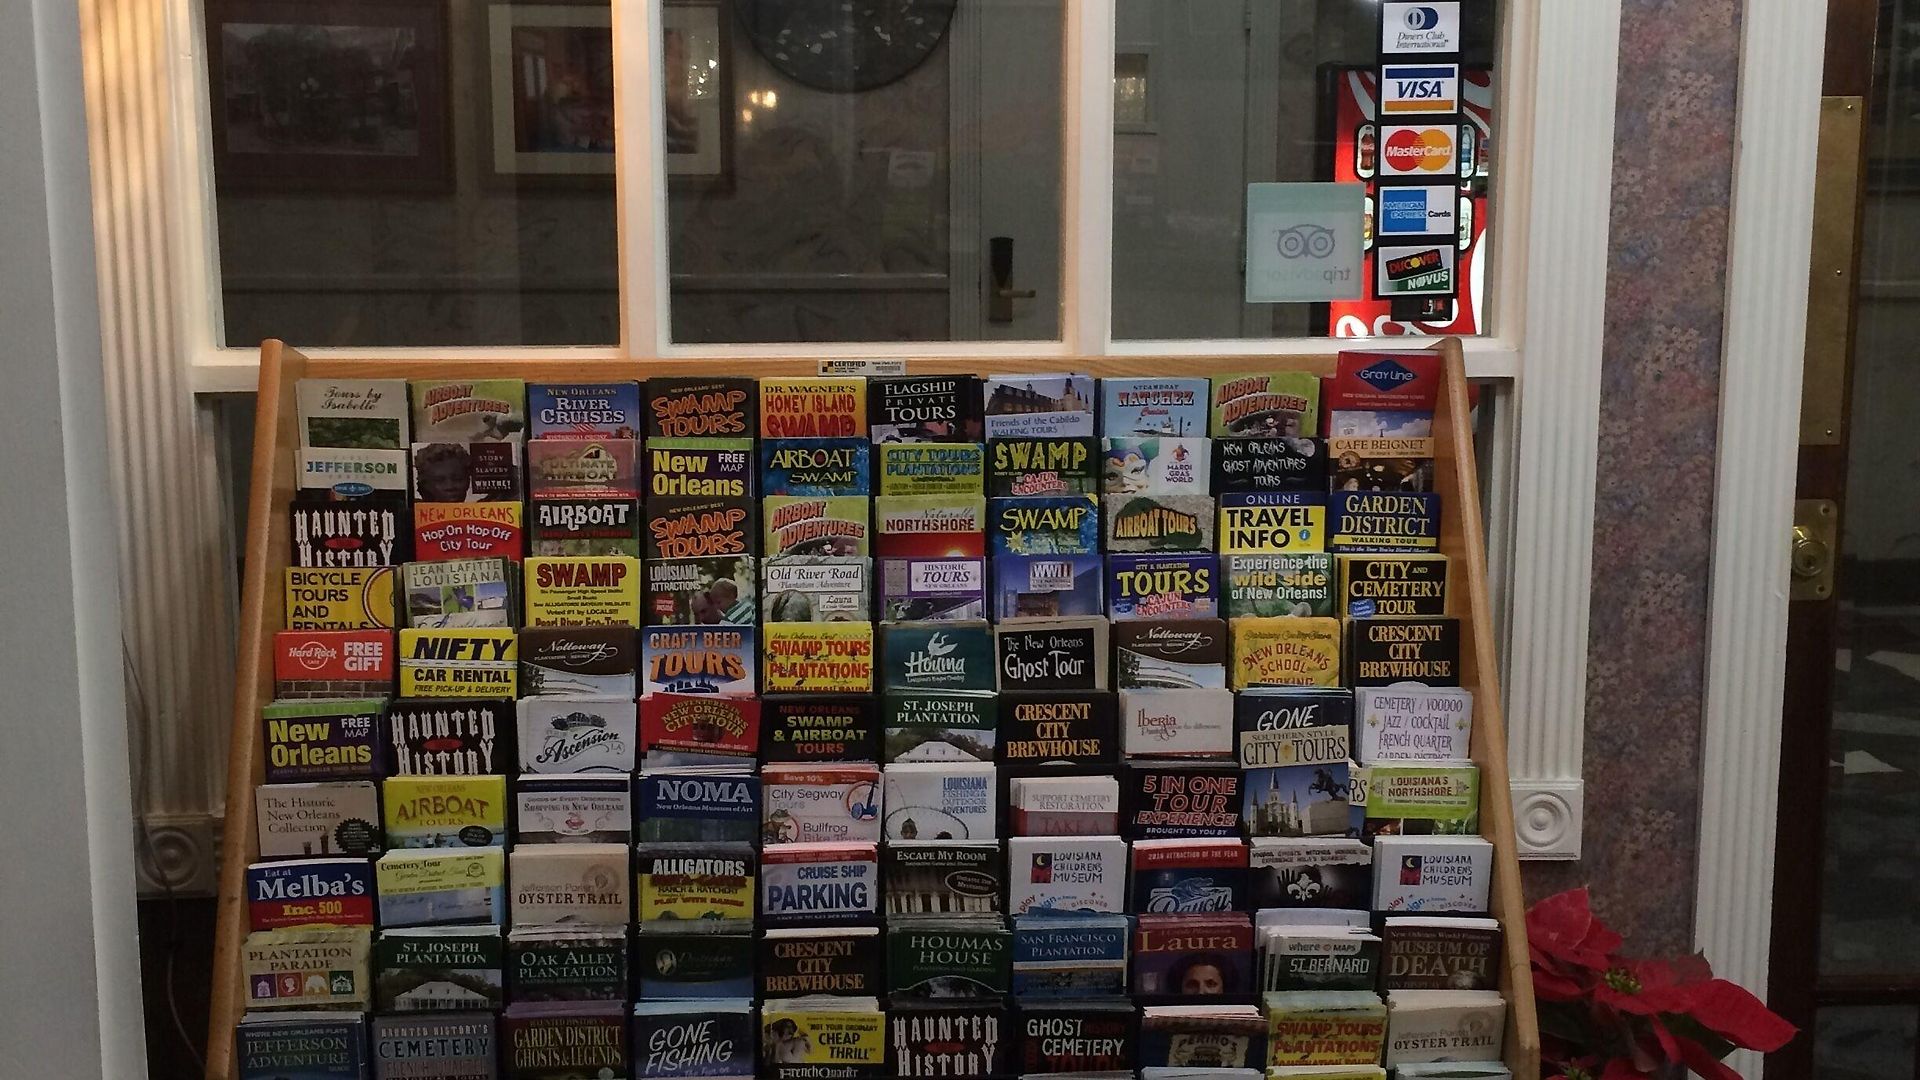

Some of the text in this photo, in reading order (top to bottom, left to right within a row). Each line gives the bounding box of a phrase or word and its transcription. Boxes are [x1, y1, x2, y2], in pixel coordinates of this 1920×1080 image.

[1397, 81, 1442, 98] VISA
[1386, 144, 1451, 157] MasterCard
[1391, 210, 1451, 219] EXPRESS Cards
[885, 382, 956, 395] FLAGSHIP
[1216, 377, 1270, 406] AIRBOAT
[424, 385, 473, 408] AIRBOAT
[885, 396, 955, 406] PRIVATE
[1118, 391, 1194, 407] NATCHEZ
[557, 399, 610, 410] RIVER
[651, 391, 746, 417] SWAMP
[766, 395, 856, 413] HONEY ISLAND
[1223, 396, 1307, 425] ADVENTURES
[432, 400, 510, 425] ADVENTURES
[541, 409, 625, 423] CRUISES
[885, 406, 956, 422] TOURS
[1223, 442, 1285, 456] NEW ORLEANS
[1336, 439, 1425, 450] CAFE BEIGNET
[653, 451, 745, 472] New FREE
[994, 441, 1087, 471] SWAMP
[306, 462, 397, 474] JEFFERSON
[721, 464, 743, 472] MAP
[653, 474, 744, 496] Orleans
[1254, 476, 1281, 486] TOURS
[1246, 495, 1300, 504] ONLINE
[1346, 495, 1427, 514] GARDEN
[420, 507, 515, 523] NEW ORLEANS
[540, 504, 629, 531] AIRBOAT
[772, 501, 826, 532] AIRBOAT
[1000, 507, 1087, 531] SWAMP
[1227, 509, 1314, 528] TRAVEL
[650, 509, 745, 538] SWAMP
[886, 518, 975, 531] NORTHSHORE
[1116, 510, 1196, 539] AIRBOAT TOURS
[1340, 516, 1430, 535] DISTRICT
[779, 520, 865, 551] ADVENTURES
[1230, 529, 1290, 549] INFO
[440, 540, 492, 551] City Tour
[657, 531, 745, 558] TOURS
[412, 561, 500, 575] JEAN LAFITTE
[537, 563, 627, 587] SWAMP
[650, 564, 698, 581] LOUISIANA
[770, 568, 859, 579] Old River Road
[291, 572, 361, 585] BICYCLE
[923, 571, 971, 583] TOURS
[1117, 569, 1210, 597] TOURS
[651, 582, 700, 591] ATTRACTIONS
[292, 589, 348, 601] TOURS
[293, 606, 329, 618] AND
[1378, 601, 1416, 614] TOUR
[650, 632, 742, 649] CRAFT BEER
[1369, 625, 1443, 642] CRESCENT
[343, 642, 383, 656] FREE
[413, 638, 514, 661] NIFTY
[1004, 636, 1084, 651] The New Orleans
[1389, 644, 1422, 659] CITY
[344, 657, 383, 671] GIFT
[650, 651, 746, 681] TOURS
[770, 662, 869, 678] PLANTATIONS
[1360, 661, 1450, 678] BREWHOUSE
[414, 669, 511, 683] CAR RENTAL
[903, 701, 974, 712] ST. JOSEPH
[1015, 703, 1091, 721] CRESCENT
[787, 716, 853, 728] SWAMP
[897, 712, 980, 724] PLANTATION
[1257, 704, 1319, 731] GONE
[269, 718, 371, 743] New FREE
[345, 729, 369, 737] MAP
[773, 729, 867, 742] & AIRBOAT
[1036, 722, 1070, 739] CITY
[795, 743, 844, 754] TOURS
[1007, 740, 1100, 758] BREWHOUSE
[1244, 737, 1346, 765] CITY TOURS
[657, 779, 753, 803] NOMA
[1143, 776, 1237, 795] 5 IN ONE
[1388, 787, 1452, 796] NORTHSHORE
[772, 790, 845, 800] City Segway
[265, 797, 336, 808] The Historic
[1039, 801, 1104, 810] RESTORATION
[1153, 794, 1228, 812] TOUR
[267, 809, 340, 821] New Orleans
[269, 823, 326, 833] Collection
[803, 823, 848, 833] Bullfrog
[896, 851, 986, 861] ESCAPE MY ROOM
[1054, 852, 1101, 861] LOUISIANA
[1424, 855, 1472, 865] LOUISIANA
[653, 859, 745, 876] ALLIGATORS
[797, 866, 867, 879] CRUISE SHIP
[1424, 866, 1472, 875] CHILDRENS
[1053, 873, 1102, 883] MUSEUM
[1423, 875, 1472, 886] MUSEUM
[257, 873, 364, 900] Melba's
[519, 893, 622, 905] OYSTER TRAIL
[768, 883, 867, 910] PARKING
[282, 901, 342, 916] Inc. 500
[911, 936, 1003, 951] HOUMAS
[1021, 933, 1116, 944] SAN FRANCISCO
[1141, 931, 1239, 952] Laura
[403, 942, 479, 953] ST. JOSEPH
[774, 941, 855, 958] CRESCENT
[1032, 947, 1106, 957] PLANTATION
[1288, 943, 1320, 951] where
[1390, 941, 1491, 954] MUSEUM OF
[250, 948, 352, 961] PLANTATION
[396, 953, 486, 964] PLANTATION
[520, 952, 615, 966] OAK ALLEY
[920, 952, 992, 965] HOUSE
[270, 960, 334, 970] PARADE
[519, 966, 618, 978] PLANTATION
[797, 958, 833, 974] CITY
[766, 974, 864, 991] BREWHOUSE
[1027, 1019, 1083, 1037] GHOST
[649, 1020, 715, 1052] GONE
[819, 1033, 860, 1045] CHEAP
[1394, 1037, 1495, 1049] OYSTER TRAIL
[379, 1038, 489, 1058] CEMETERY
[1042, 1039, 1125, 1057] CEMETERY
[645, 1040, 733, 1075] FISHING
